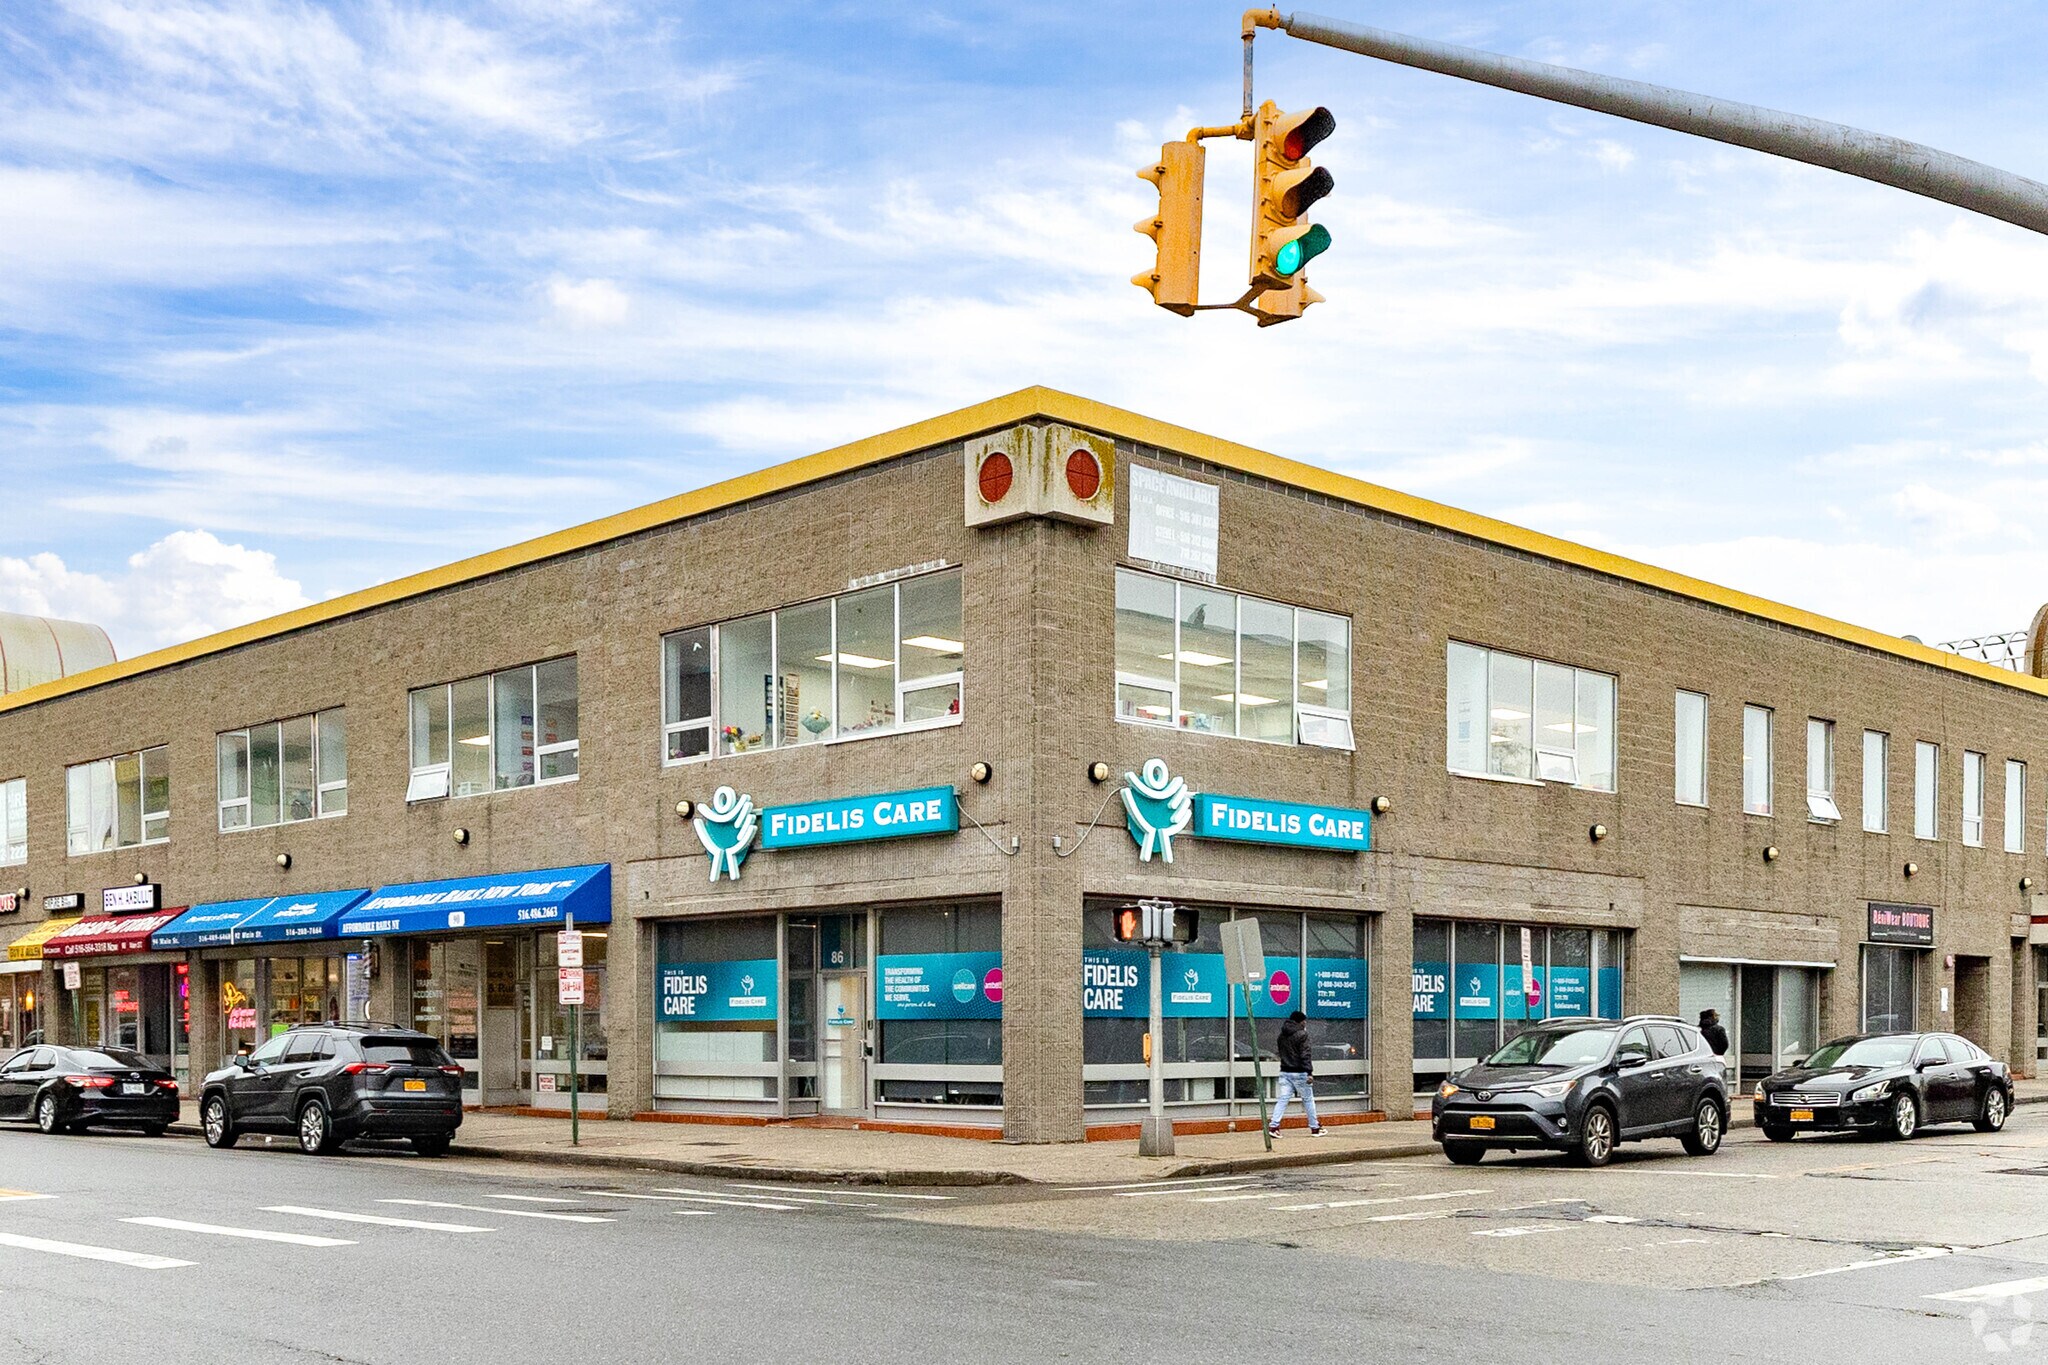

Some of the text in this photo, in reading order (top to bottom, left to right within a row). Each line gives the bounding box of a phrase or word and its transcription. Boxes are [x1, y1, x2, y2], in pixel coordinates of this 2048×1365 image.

[771, 799, 942, 837] FIDELIS CARE
[1212, 803, 1365, 841] FIDELIS CARE
[360, 891, 447, 910] AFFORDABLE
[831, 951, 844, 963] 86
[664, 975, 707, 995] FIDELIS
[1084, 965, 1138, 987] FIDELIS
[1412, 975, 1445, 993] IDELIS
[664, 996, 695, 1015] CARE
[1084, 988, 1123, 1010] CARE
[1412, 994, 1434, 1012] ARE
